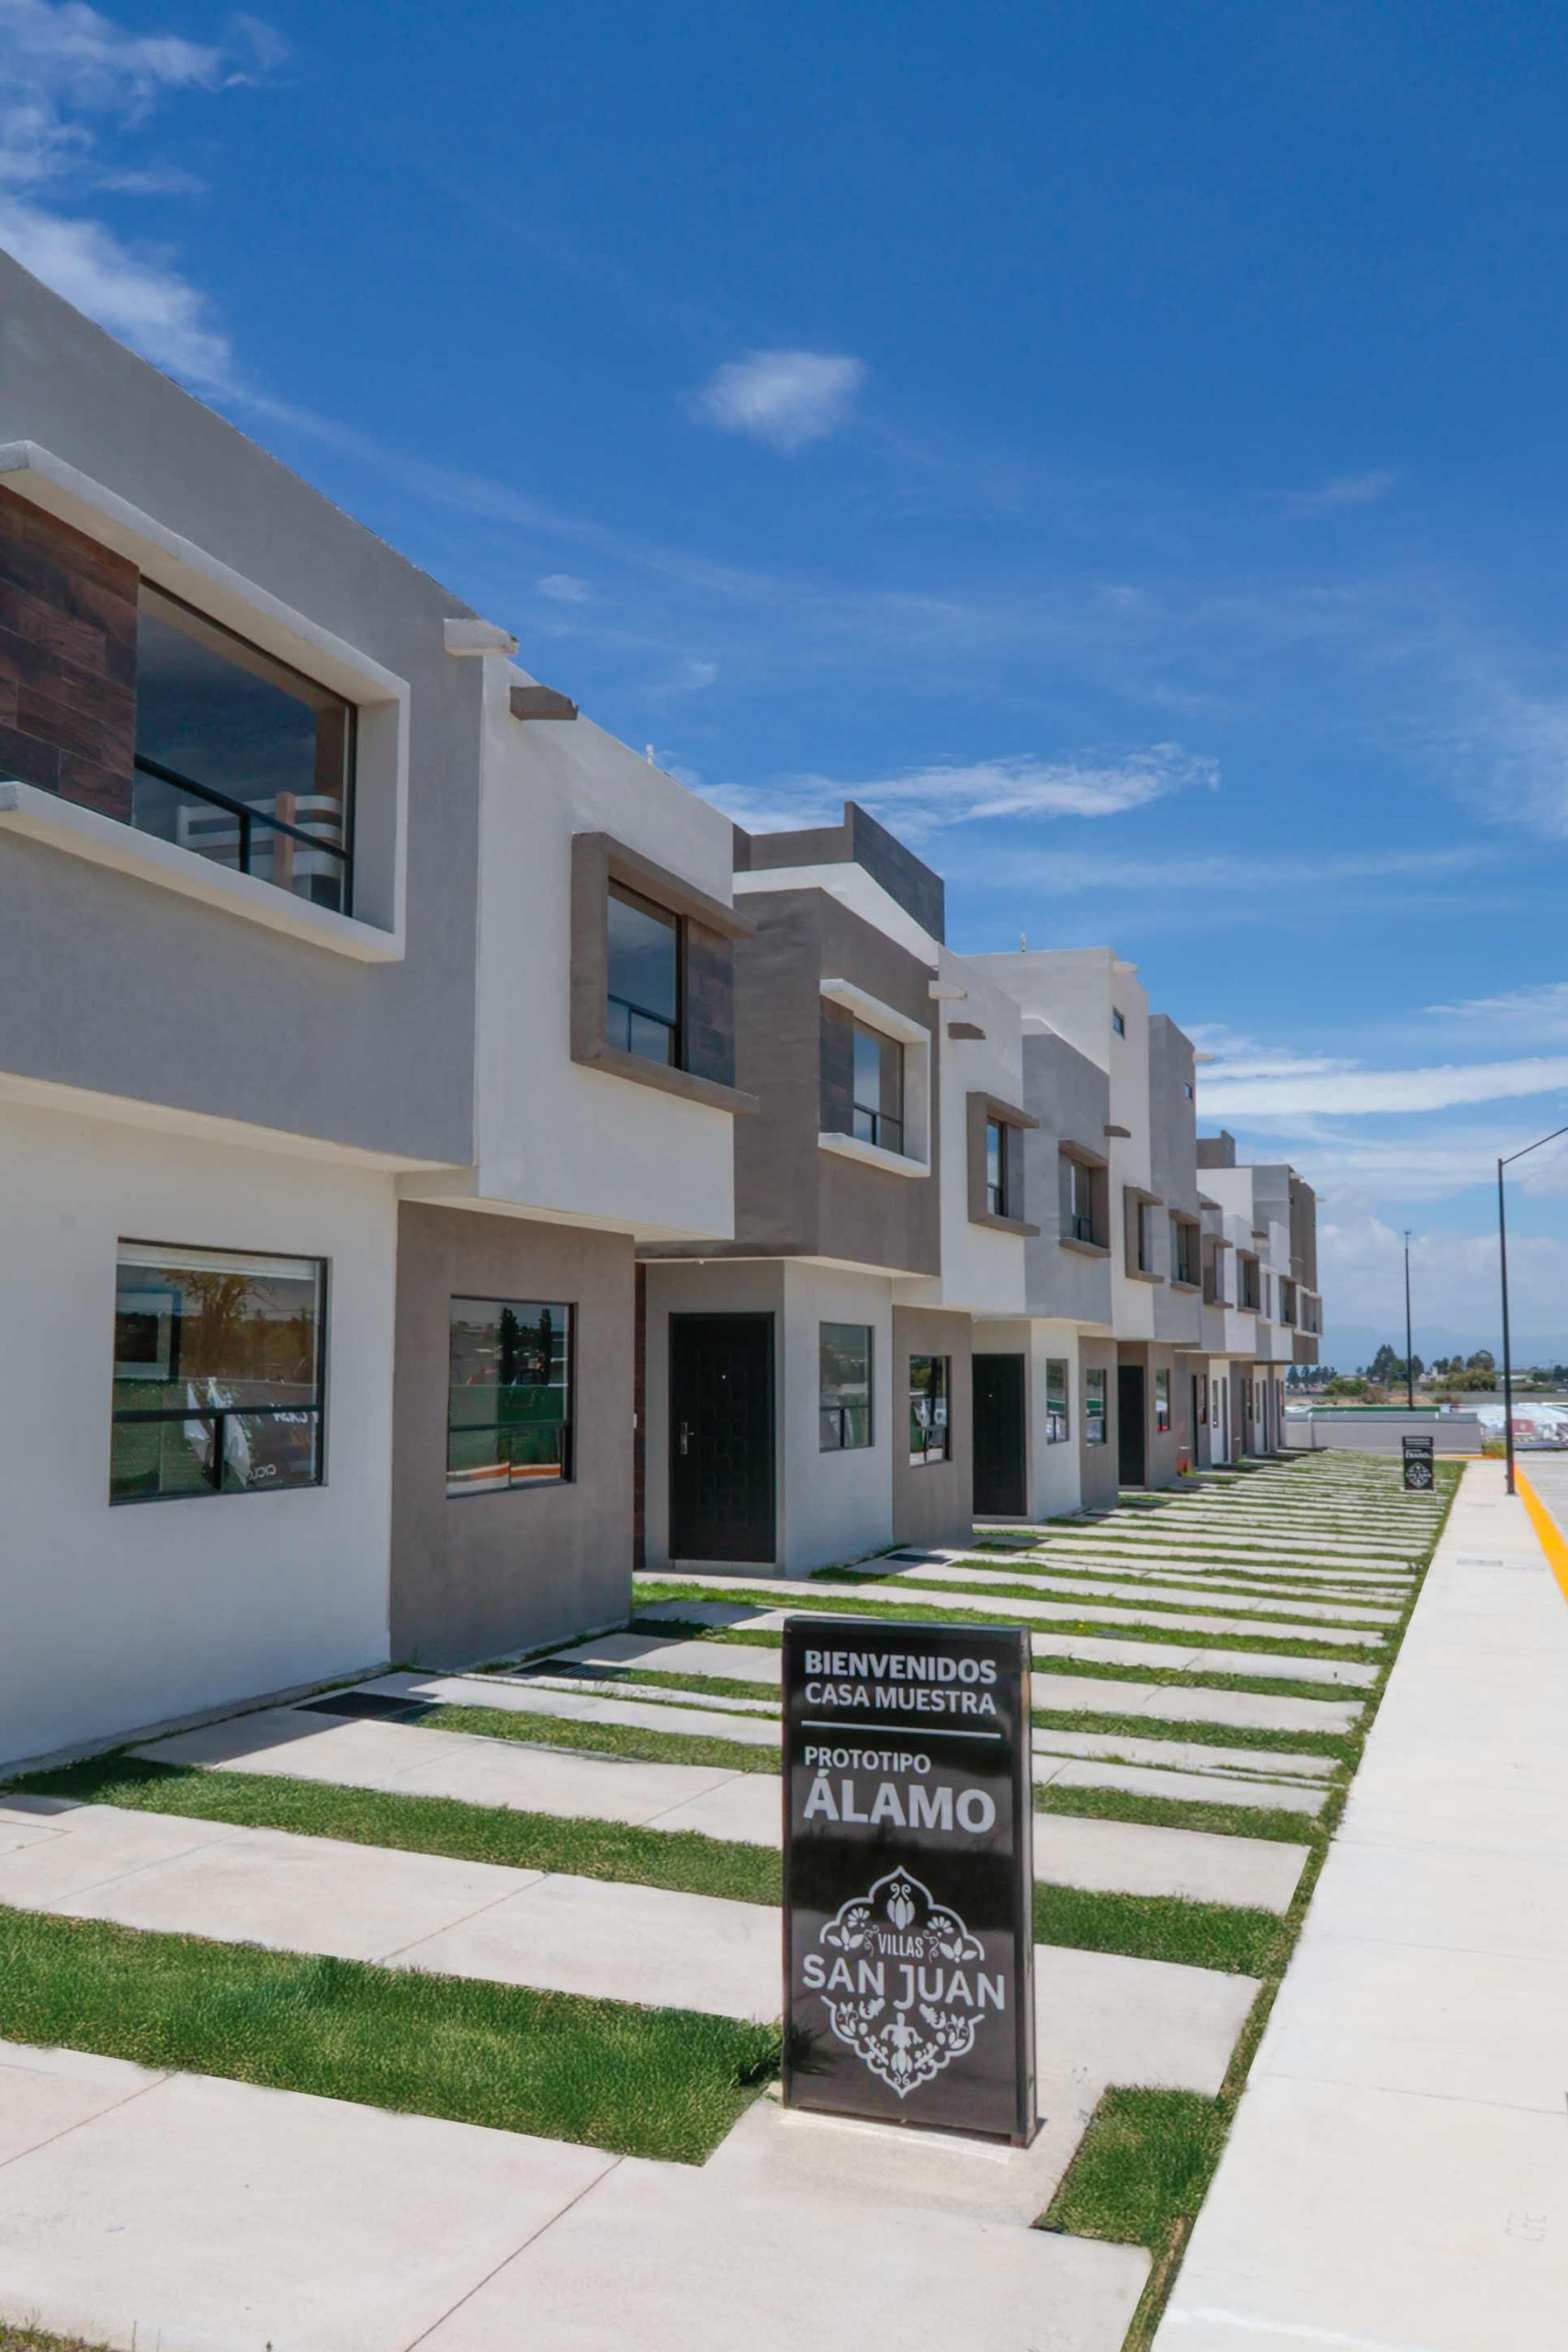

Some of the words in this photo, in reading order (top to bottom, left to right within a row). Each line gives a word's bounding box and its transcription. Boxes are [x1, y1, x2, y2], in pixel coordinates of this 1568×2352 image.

[805, 1649, 998, 1684] BIENVENIDOS
[805, 1681, 870, 1707] CASA
[875, 1686, 997, 1715] MUESTRA
[805, 1746, 931, 1774] PROTOTIPO
[803, 1769, 996, 1834] ÁLAMO
[878, 1933, 924, 1959] VILLAS
[802, 1953, 885, 1996] SAN
[893, 1964, 1005, 2010] JUAN
